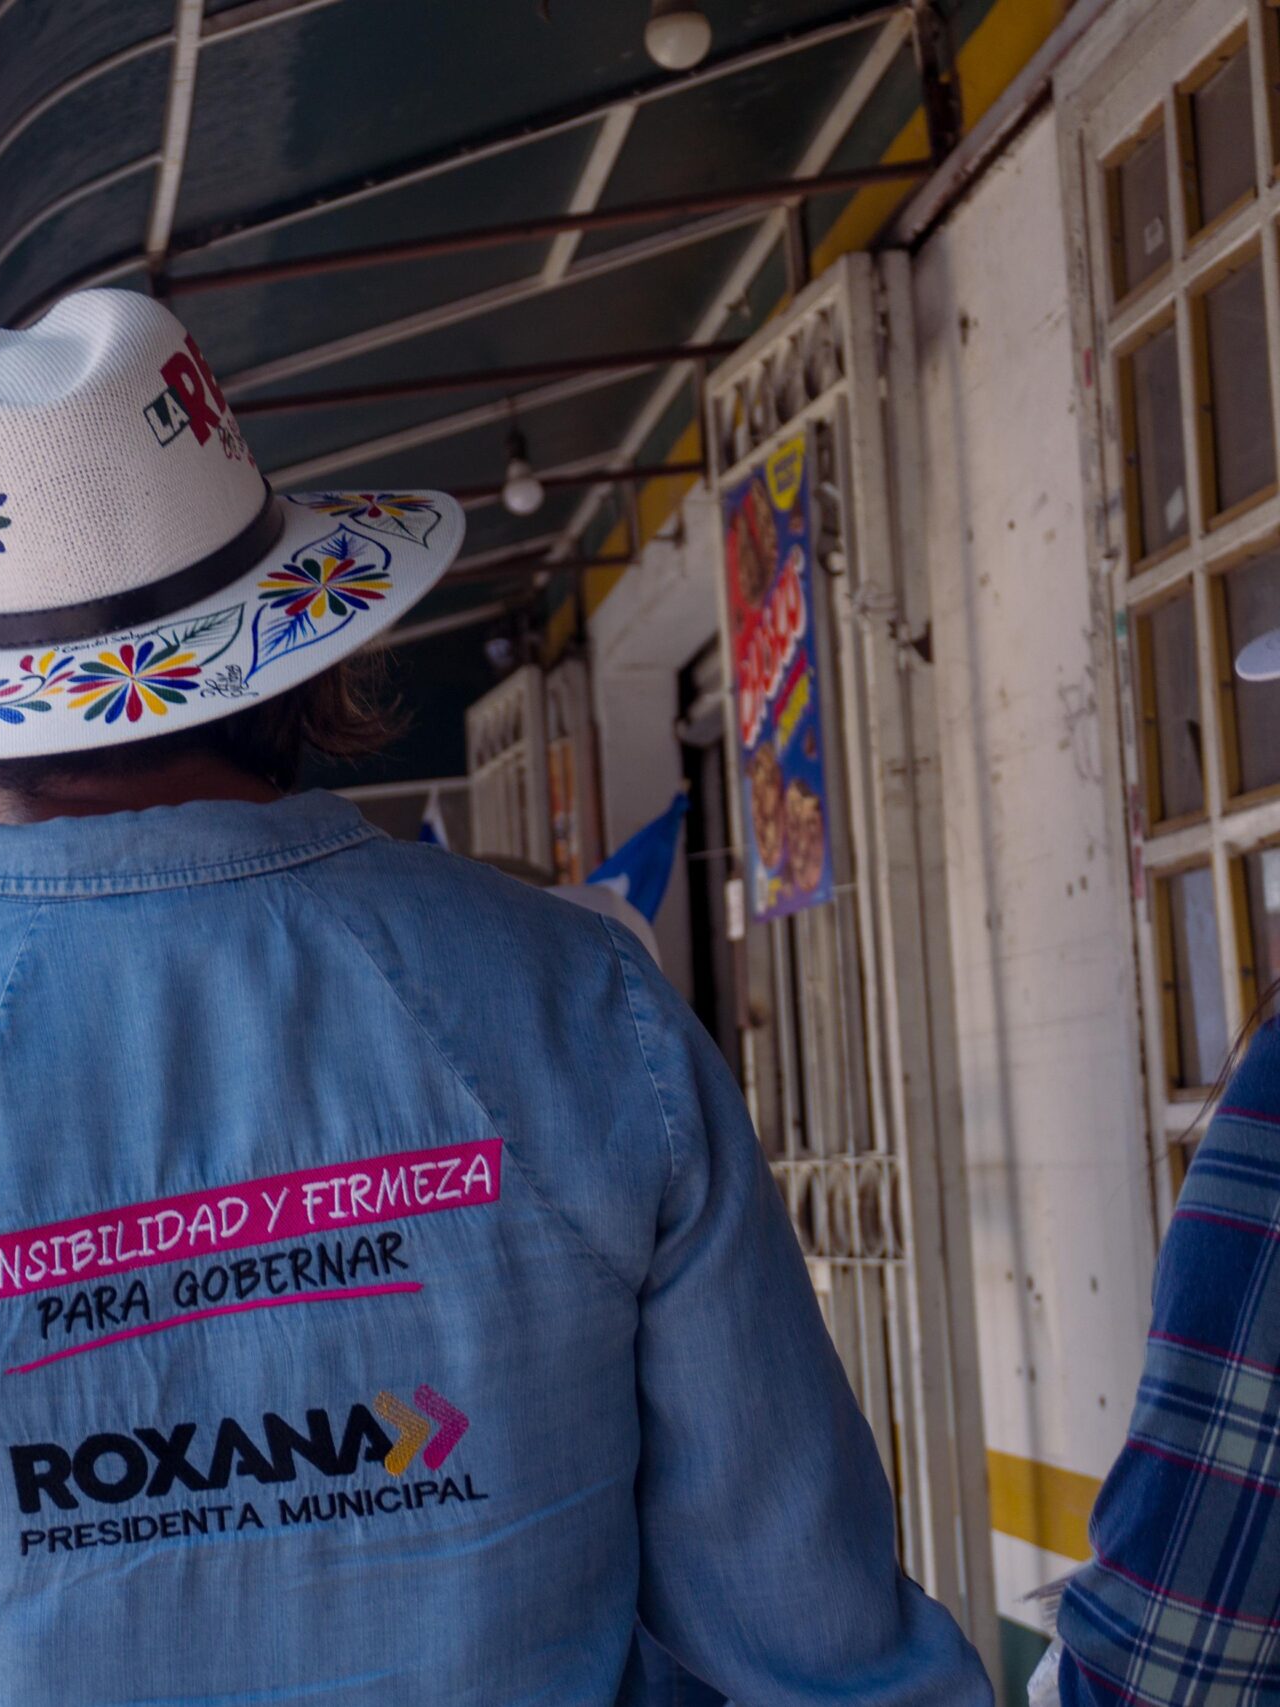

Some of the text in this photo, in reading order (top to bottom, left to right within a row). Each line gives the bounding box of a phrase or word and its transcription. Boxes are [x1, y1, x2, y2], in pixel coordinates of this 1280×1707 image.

[145, 391, 191, 445] LA
[261, 1187, 289, 1233] Y
[301, 1153, 492, 1224] FIRMEZA
[37, 1231, 408, 1340] PARA GOBERNAR
[9, 1403, 394, 1514] ROXANA
[20, 1473, 488, 1556] PRESIDENTA MUNICIPAL
